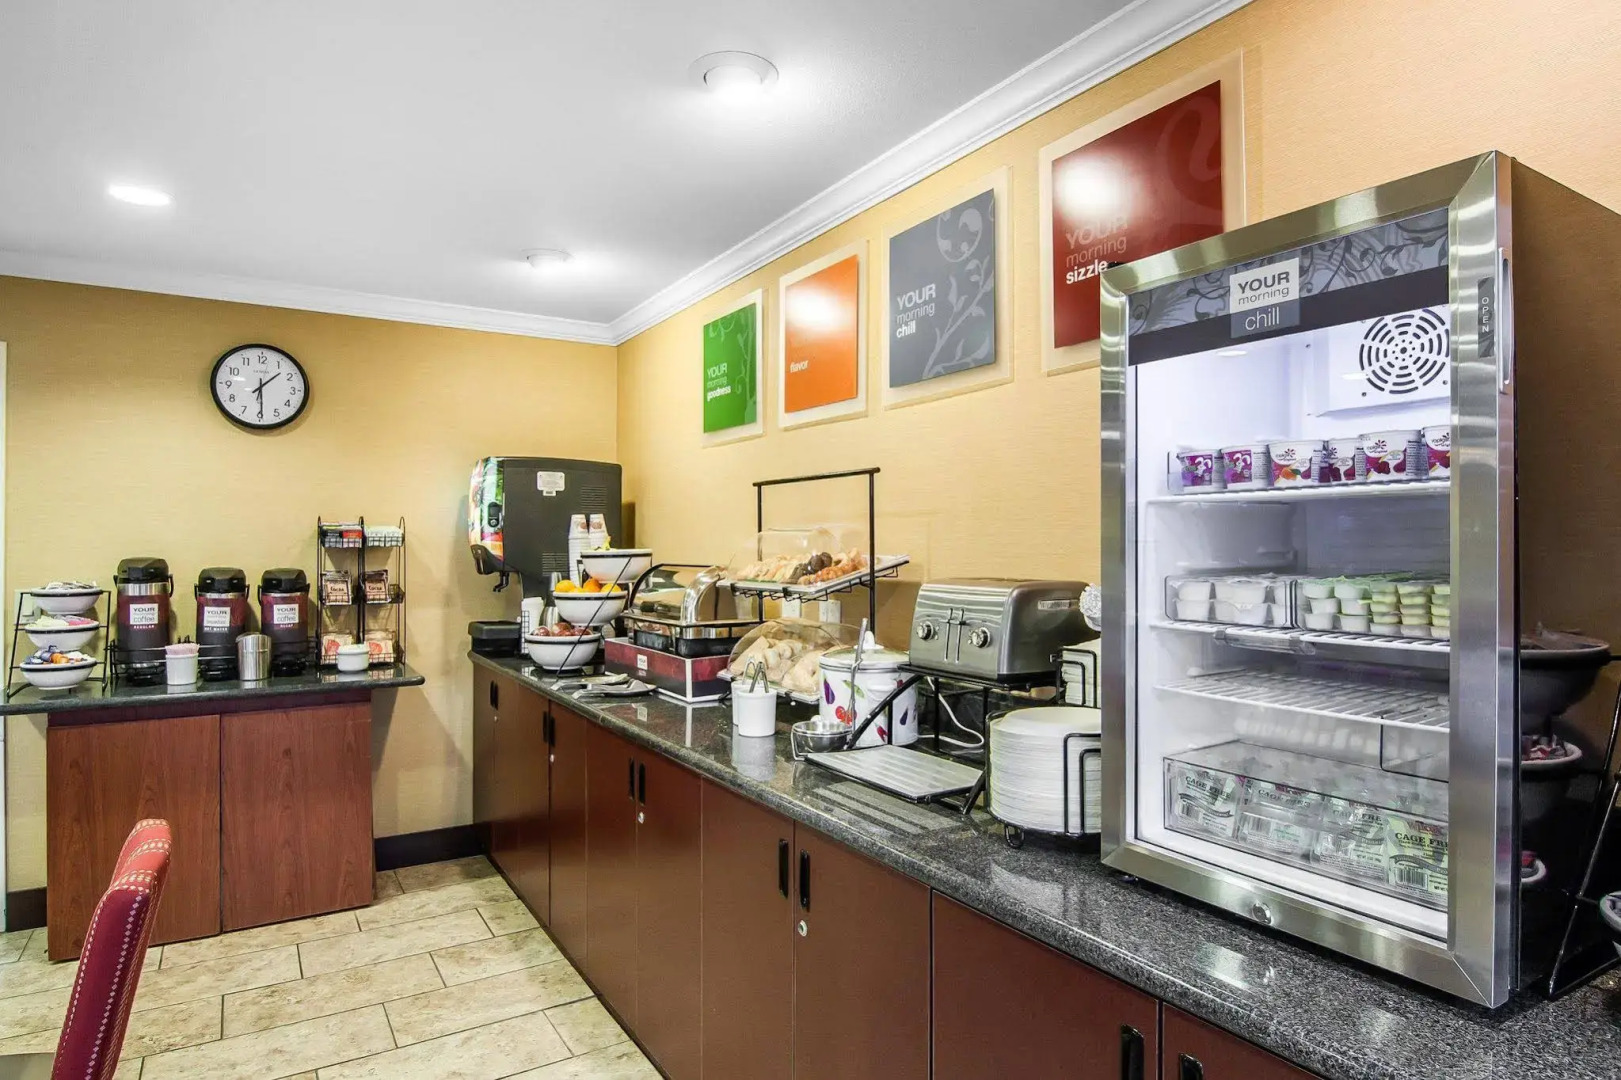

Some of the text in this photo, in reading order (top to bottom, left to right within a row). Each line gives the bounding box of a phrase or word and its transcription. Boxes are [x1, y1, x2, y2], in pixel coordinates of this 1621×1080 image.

[1065, 216, 1128, 250] YOUR
[1066, 236, 1127, 267] morning
[1066, 259, 1108, 285] sizzle
[1238, 271, 1290, 294] YOUR
[897, 283, 936, 310] YOUR
[1238, 287, 1289, 305] morning
[897, 302, 935, 324] morning
[1481, 296, 1490, 333] OPEN
[1245, 306, 1280, 330] chill
[896, 319, 916, 338] chill
[243, 357, 250, 366] 11
[257, 355, 268, 364] 12
[276, 361, 280, 369] 1
[229, 367, 240, 376] 10
[707, 362, 728, 378] YOUR
[286, 373, 293, 381] 2
[225, 380, 232, 389] 9
[289, 387, 296, 395] 3
[707, 385, 731, 402] goodness
[228, 394, 236, 402] 8
[284, 399, 291, 408] 4
[241, 406, 247, 414] 7
[257, 410, 263, 419] 6
[273, 409, 280, 417] 5
[133, 615, 155, 623] coffee
[276, 615, 297, 623] coffee
[1395, 832, 1426, 844] CAGE
